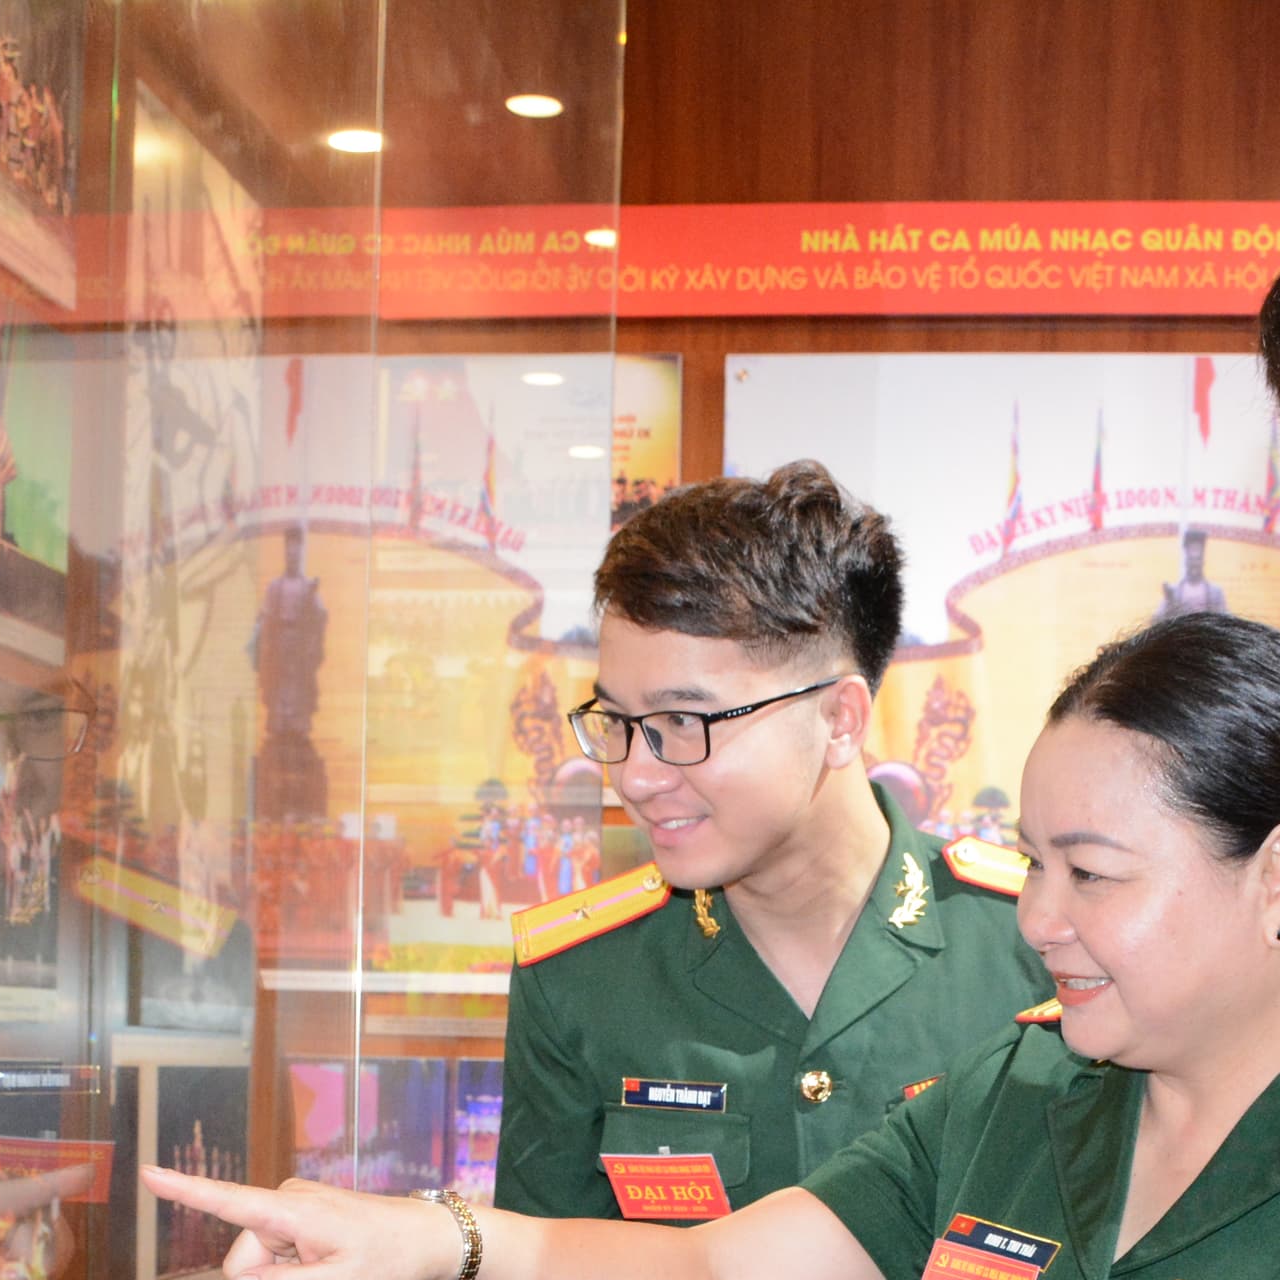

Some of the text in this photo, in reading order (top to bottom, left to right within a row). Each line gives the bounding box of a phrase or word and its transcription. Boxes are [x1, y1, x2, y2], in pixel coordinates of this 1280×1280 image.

[801, 223, 860, 253] NHÀ
[869, 222, 922, 252] HÁT
[929, 229, 971, 252] CA
[979, 222, 1043, 251] MÚA
[1050, 229, 1133, 258] NHẠC
[1141, 222, 1223, 251] QUÂN
[684, 262, 732, 291] XÂY
[736, 265, 808, 295] DỰNG
[813, 260, 850, 290] VÀ
[854, 259, 907, 290] BẢO
[912, 261, 943, 294] VỆ
[948, 253, 980, 290] TỔ
[985, 258, 1062, 289] QUỐC
[1068, 261, 1115, 294] VIỆT
[1122, 265, 1178, 289] NAM
[1184, 263, 1218, 289] XÃ
[1224, 261, 1268, 294] HỘI
[625, 1181, 714, 1204] ĐẠI HỘI
